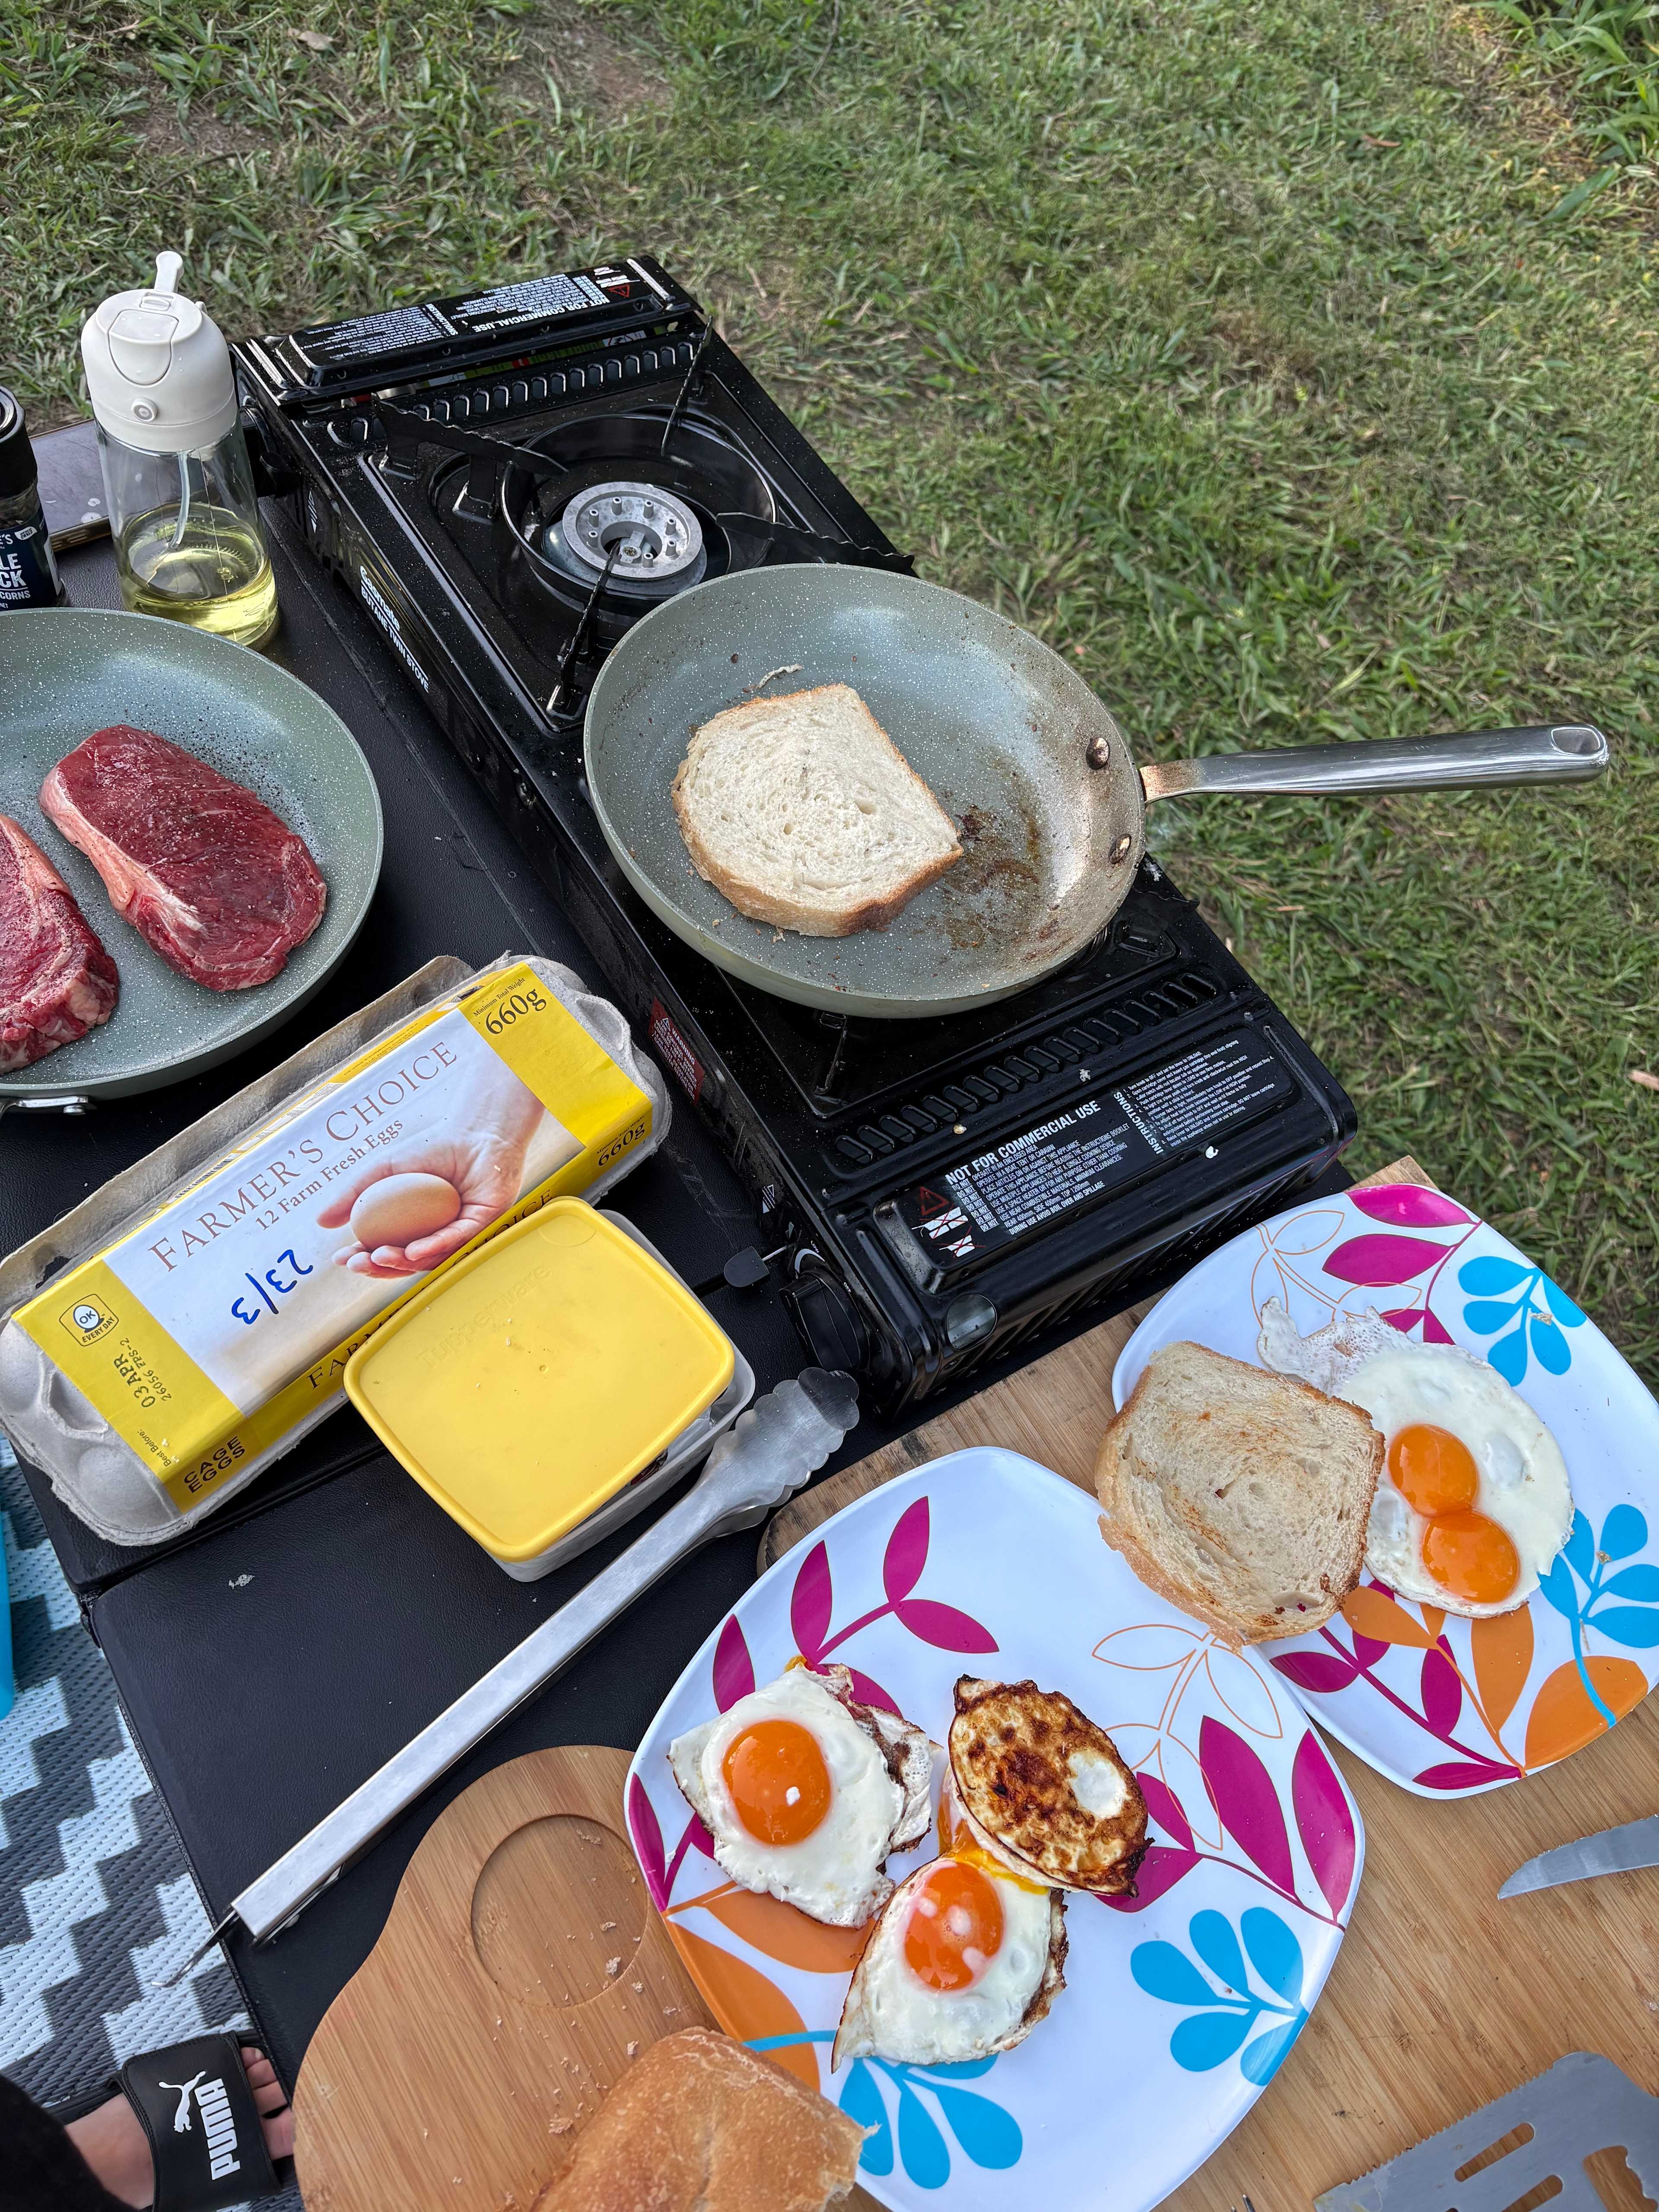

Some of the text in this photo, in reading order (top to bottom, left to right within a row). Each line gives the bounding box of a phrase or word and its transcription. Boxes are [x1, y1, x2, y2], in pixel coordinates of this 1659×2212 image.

[425, 303, 458, 336] INSTRUCTIONS
[471, 297, 610, 332] NOT FOR COMMERCIAL USE
[0, 570, 26, 588] CK
[0, 591, 31, 600] CORNS
[360, 566, 400, 631] Gasmate
[361, 585, 429, 693] BUTANE TWIN STOVE
[472, 977, 525, 1017] Minimum Total Weight
[485, 988, 547, 1034] 660g
[654, 1022, 670, 1048] LOADING
[672, 1027, 695, 1065] WARNING
[598, 1122, 645, 1166] 660g
[944, 1100, 1101, 1185] NOT FOR COMMERCIAL USE
[1113, 1091, 1164, 1154] INSTRUCTIONS
[147, 1138, 323, 1272] FARMER'S
[326, 1041, 457, 1141] CHOICE
[255, 1120, 403, 1230] 12 Farm Fresh Eggs
[956, 1189, 965, 1198] DO
[963, 1184, 975, 1194] NOT
[976, 1173, 998, 1188] OPERATE
[1015, 1157, 1030, 1167] TENT
[1027, 1153, 1036, 1161] OR
[1034, 1143, 1056, 1158] CARAVAN
[959, 1178, 970, 1187] NOT
[971, 1166, 993, 1181] OPERATE
[996, 1160, 1004, 1169] AN
[1002, 1149, 1027, 1165] ENCLOSED
[1025, 1144, 1039, 1154] AREA
[960, 1139, 1081, 1205] DO NOT PLACE ARTICLES ON OR AGAINST THIS APPLIANCE
[965, 1122, 1130, 1211] DO NOT OPERATE THIS APPLIANCE BEFORE READING THE INSTRUCTIONS BOOKLET
[970, 1209, 979, 1218] DO
[977, 1204, 989, 1214] NOT
[989, 1198, 1001, 1208] USE
[998, 1188, 1022, 1203] MULTIPLE
[1019, 1175, 1047, 1193] APPLIANCES
[1044, 1171, 1053, 1179] TO
[1051, 1166, 1064, 1176] HEAT
[1065, 1156, 1083, 1169] SINGLE
[1081, 1147, 1101, 1161] COOKING
[1099, 1139, 1116, 1151] DEVICE
[975, 1216, 984, 1225] DO
[982, 1211, 994, 1221] NOT
[994, 1205, 1006, 1214] USE
[1007, 1195, 1024, 1208] SPACE
[1021, 1187, 1040, 1201] HEATER
[1038, 1184, 1047, 1192] OR
[1044, 1179, 1056, 1189] FOR
[1054, 1174, 1065, 1184] ANY
[1062, 1164, 1084, 1179] PURPOSE
[1082, 1157, 1098, 1169] OTHER
[1095, 1151, 1109, 1162] THAN
[1107, 1142, 1128, 1156] COOKING
[979, 1223, 989, 1231] DO
[987, 1217, 998, 1227] NOT
[999, 1211, 1011, 1221] USE
[1008, 1205, 1023, 1217] NEAR
[1020, 1190, 1052, 1210] COMBUSTIBLE
[1074, 1167, 1096, 1182] MINIMUM
[1003, 1217, 1018, 1228] REAR
[1033, 1202, 1046, 1213] SIDE
[1060, 1189, 1071, 1198] TOP
[1070, 1180, 1090, 1193] 1200mm
[1008, 1180, 1105, 1235] DURING USE AVOID BOIL OVER AND SPILLAGE
[452, 1189, 553, 1267] OICE
[231, 1249, 314, 1324] 23/3
[79, 1310, 96, 1324] OK
[81, 1316, 114, 1343] EVERY DAY
[416, 1265, 553, 1369] Tupperware
[113, 1353, 156, 1408] 03 APR
[142, 1369, 172, 1401] 26056
[137, 1429, 172, 1467] Best Before:
[184, 1436, 241, 1484] CAGE
[188, 1445, 245, 1494] EGGS
[194, 2079, 241, 2180] PUMA
